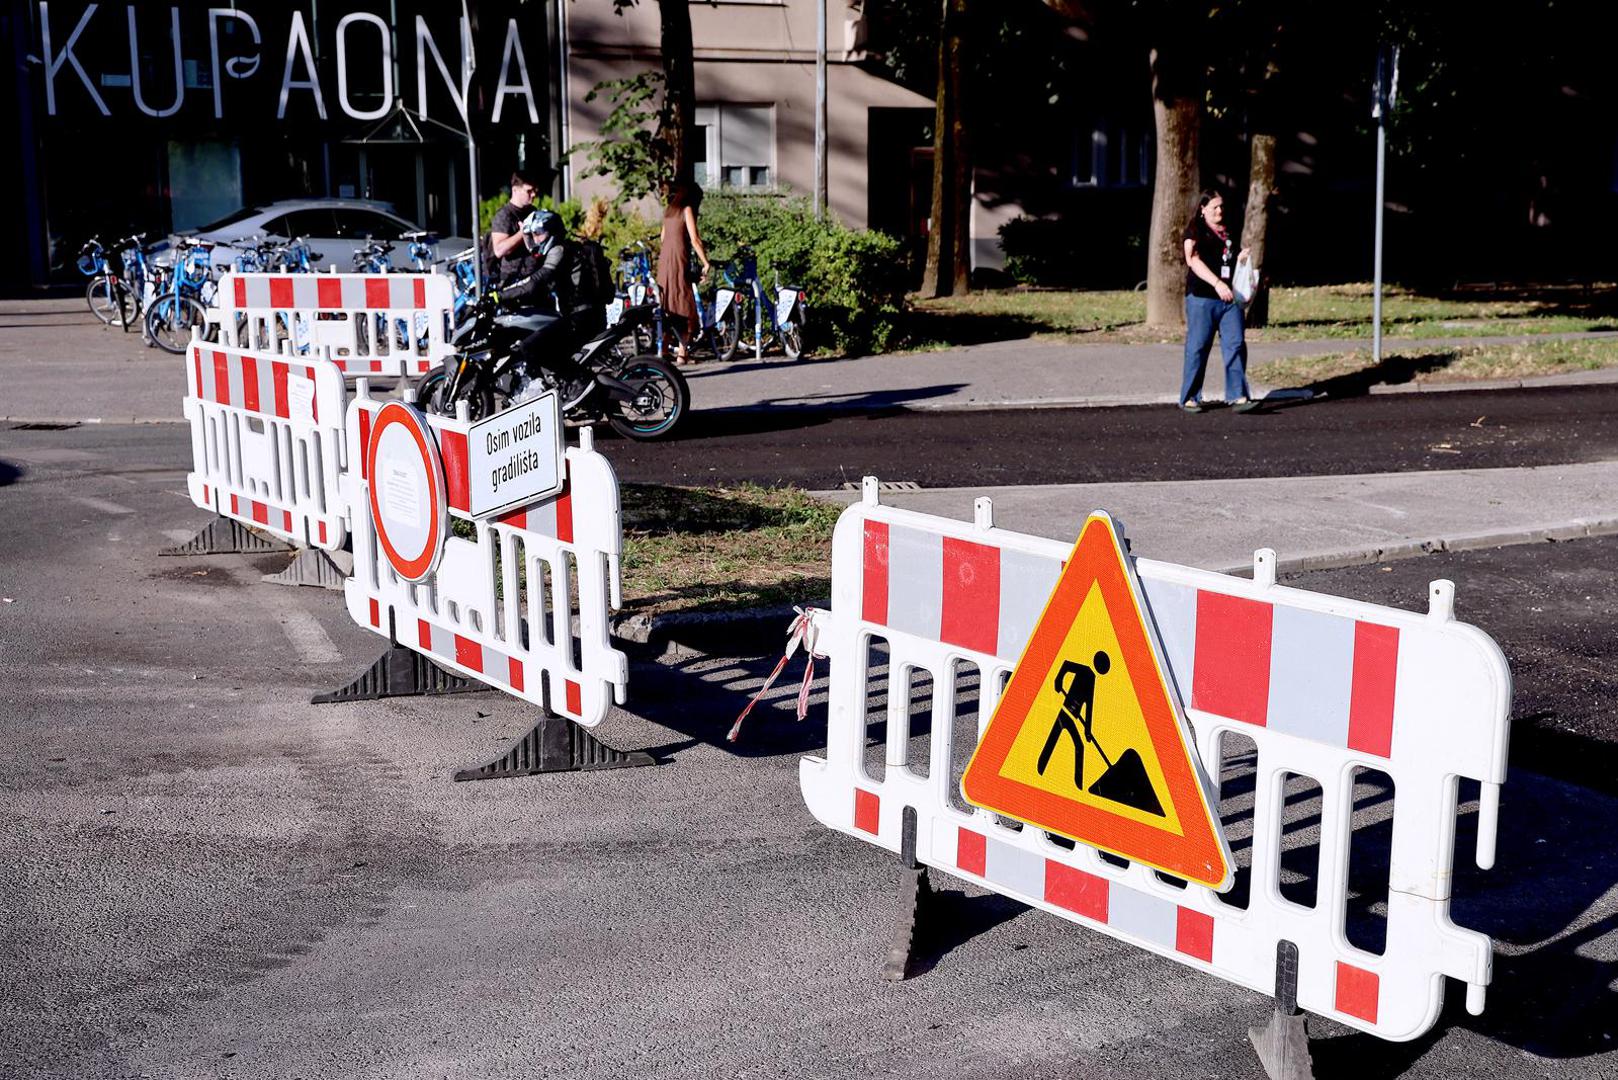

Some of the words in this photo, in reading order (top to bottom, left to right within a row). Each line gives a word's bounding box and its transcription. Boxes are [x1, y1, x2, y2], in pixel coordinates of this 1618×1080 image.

[39, 1, 540, 124] KUPAONA
[486, 429, 510, 456] Osim
[512, 411, 541, 443] vozila
[492, 448, 539, 493] gradilišta
